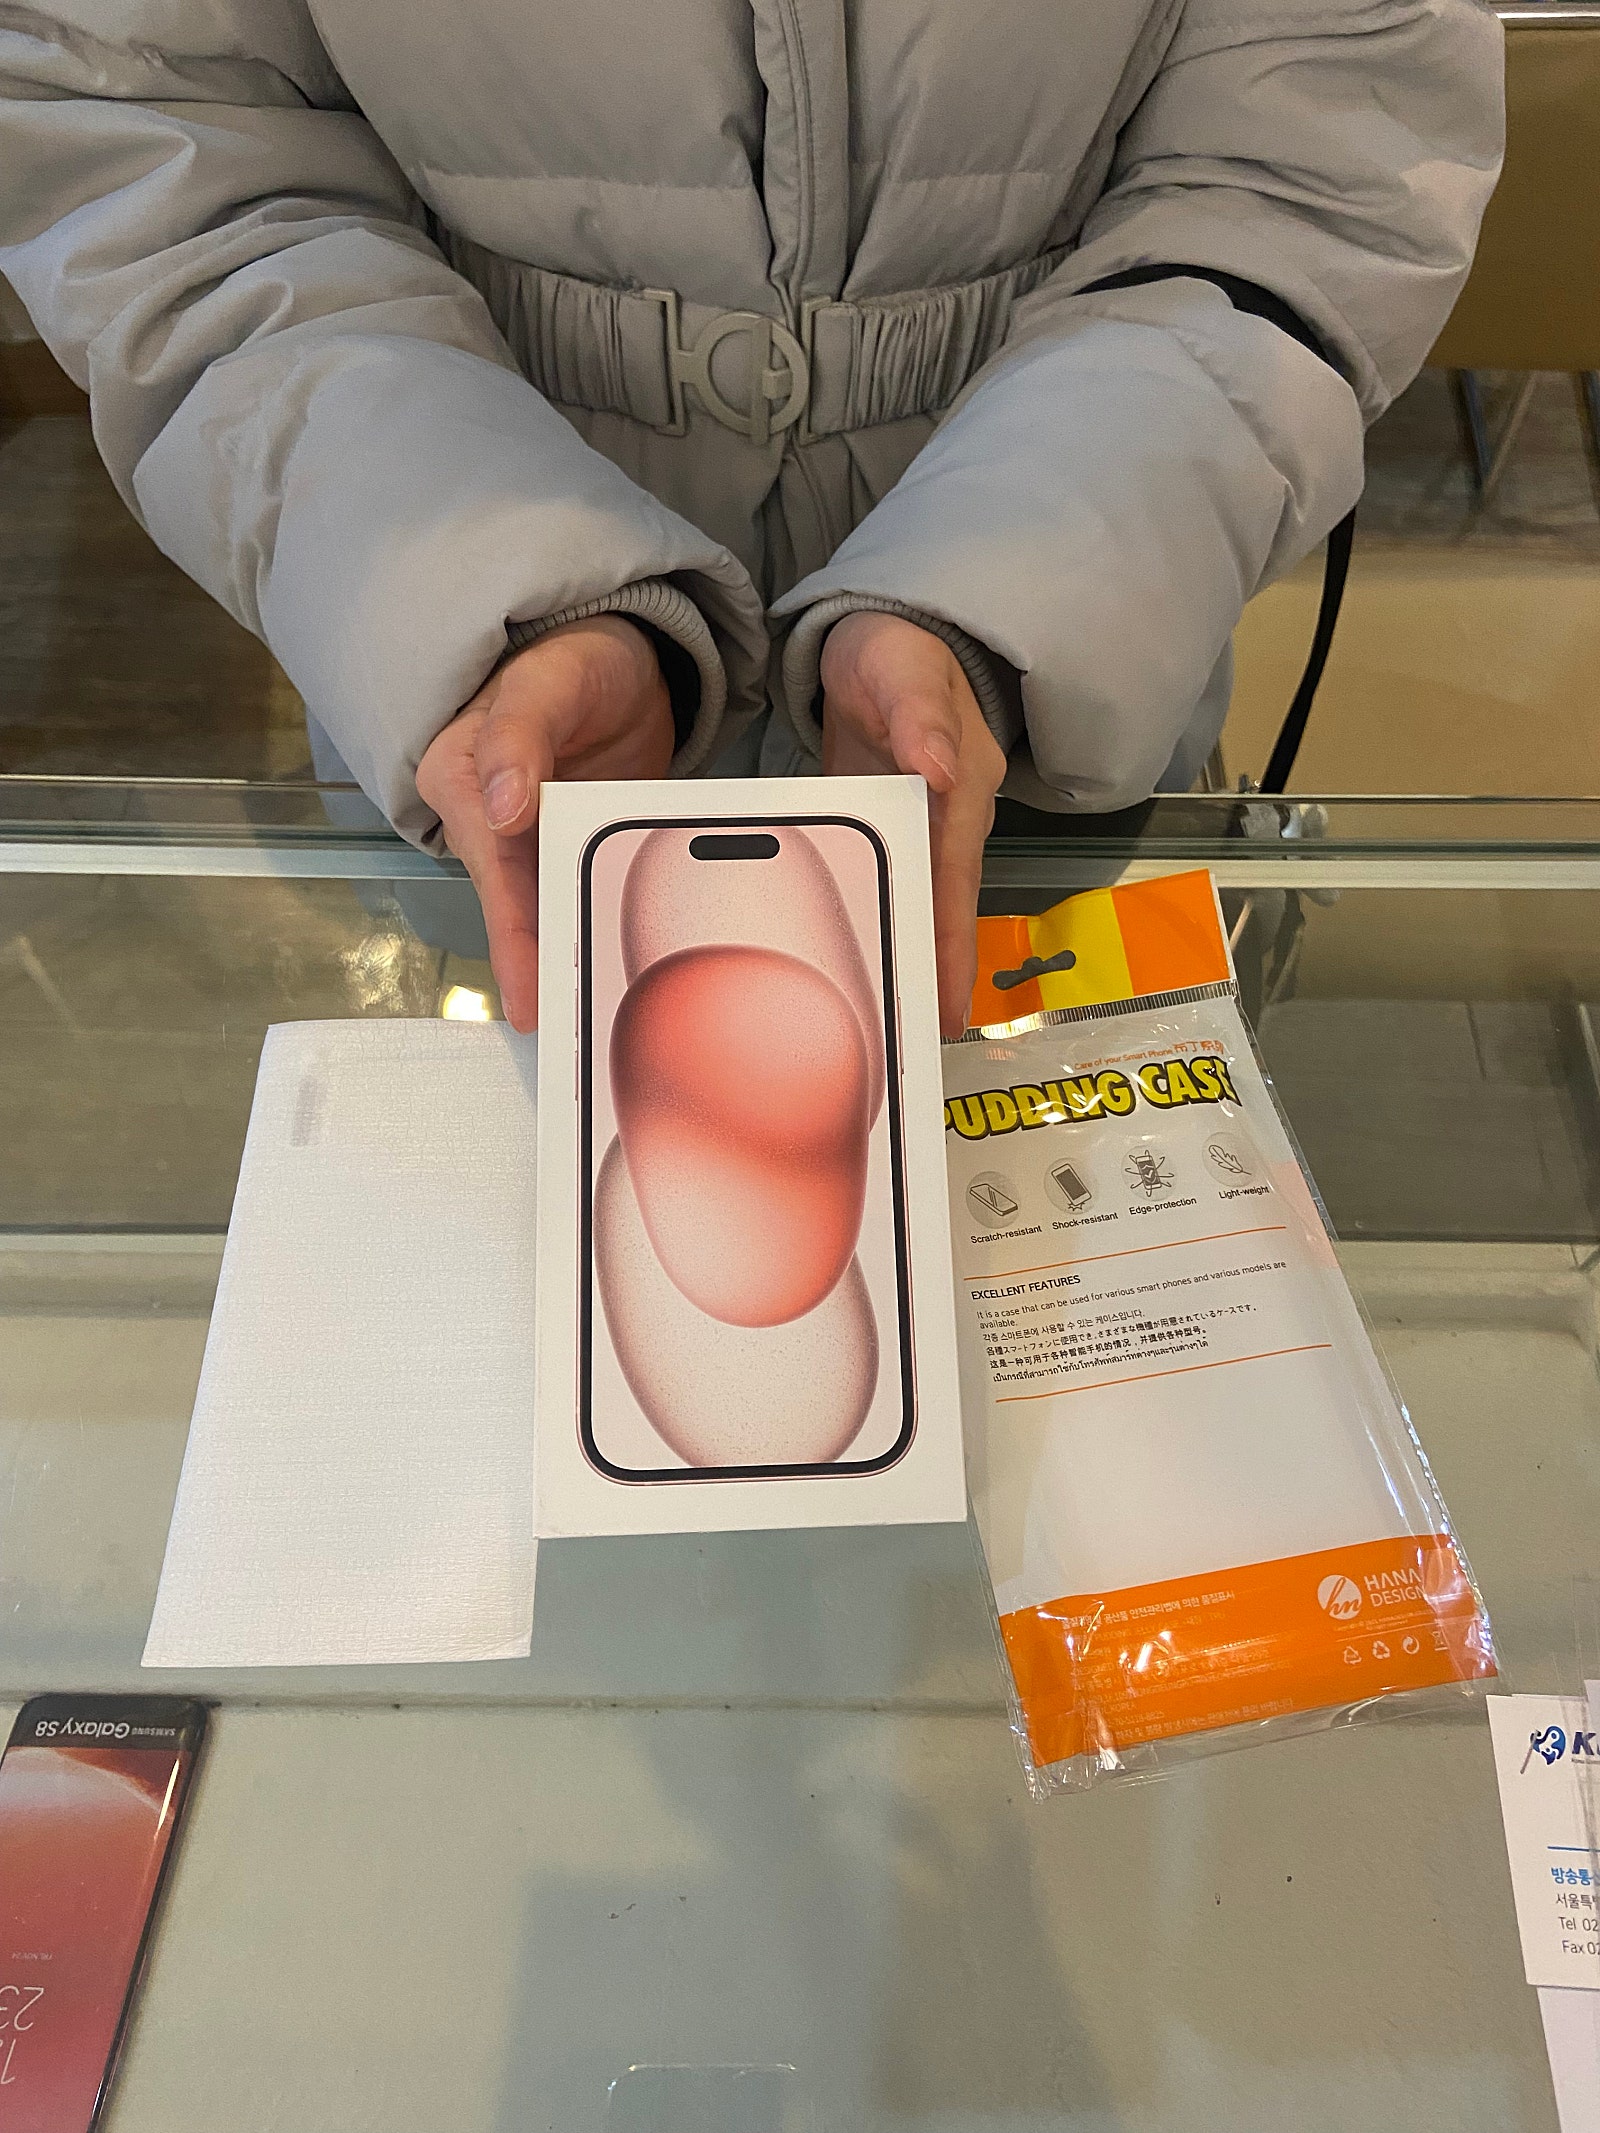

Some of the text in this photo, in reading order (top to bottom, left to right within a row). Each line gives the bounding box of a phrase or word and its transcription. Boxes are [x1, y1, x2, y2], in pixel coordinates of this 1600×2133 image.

[1074, 1047, 1173, 1070] Care of your Smart Phone
[1218, 1183, 1270, 1200] Light-weight
[1129, 1196, 1197, 1216] Edge-protection
[1052, 1210, 1119, 1230] Shock-resistant
[970, 1224, 1042, 1244] Scratch-resistant
[971, 1274, 1081, 1300] EXCELLENT FEATURES
[976, 1310, 983, 1319] It
[985, 1309, 992, 1318] is
[1001, 1308, 1020, 1317] case
[1021, 1304, 1038, 1314] that
[1040, 1301, 1055, 1311] can
[1057, 1298, 1068, 1308] be
[1069, 1295, 1089, 1306] used
[1091, 1292, 1103, 1302] for
[1104, 1287, 1135, 1299] various
[1136, 1282, 1161, 1294] smart
[1162, 1276, 1192, 1290] phones
[1193, 1273, 1209, 1283] and
[1210, 1267, 1240, 1280] various
[1241, 1262, 1272, 1274] models
[1273, 1260, 1287, 1269] are
[979, 1319, 1018, 1330] available.
[1000, 1327, 1040, 1341] 스마트폰에
[1041, 1323, 1065, 1335] 사용할
[1067, 1321, 1075, 1330] 수
[1077, 1318, 1094, 1328] 있는
[1095, 1308, 1145, 1325] 케이스입니다.
[1363, 1567, 1422, 1591] HANA
[35, 1717, 176, 1739] SAMSUNG Galaxy S8
[1558, 1916, 1577, 1931] Tel
[1562, 1939, 1585, 1955] Fax
